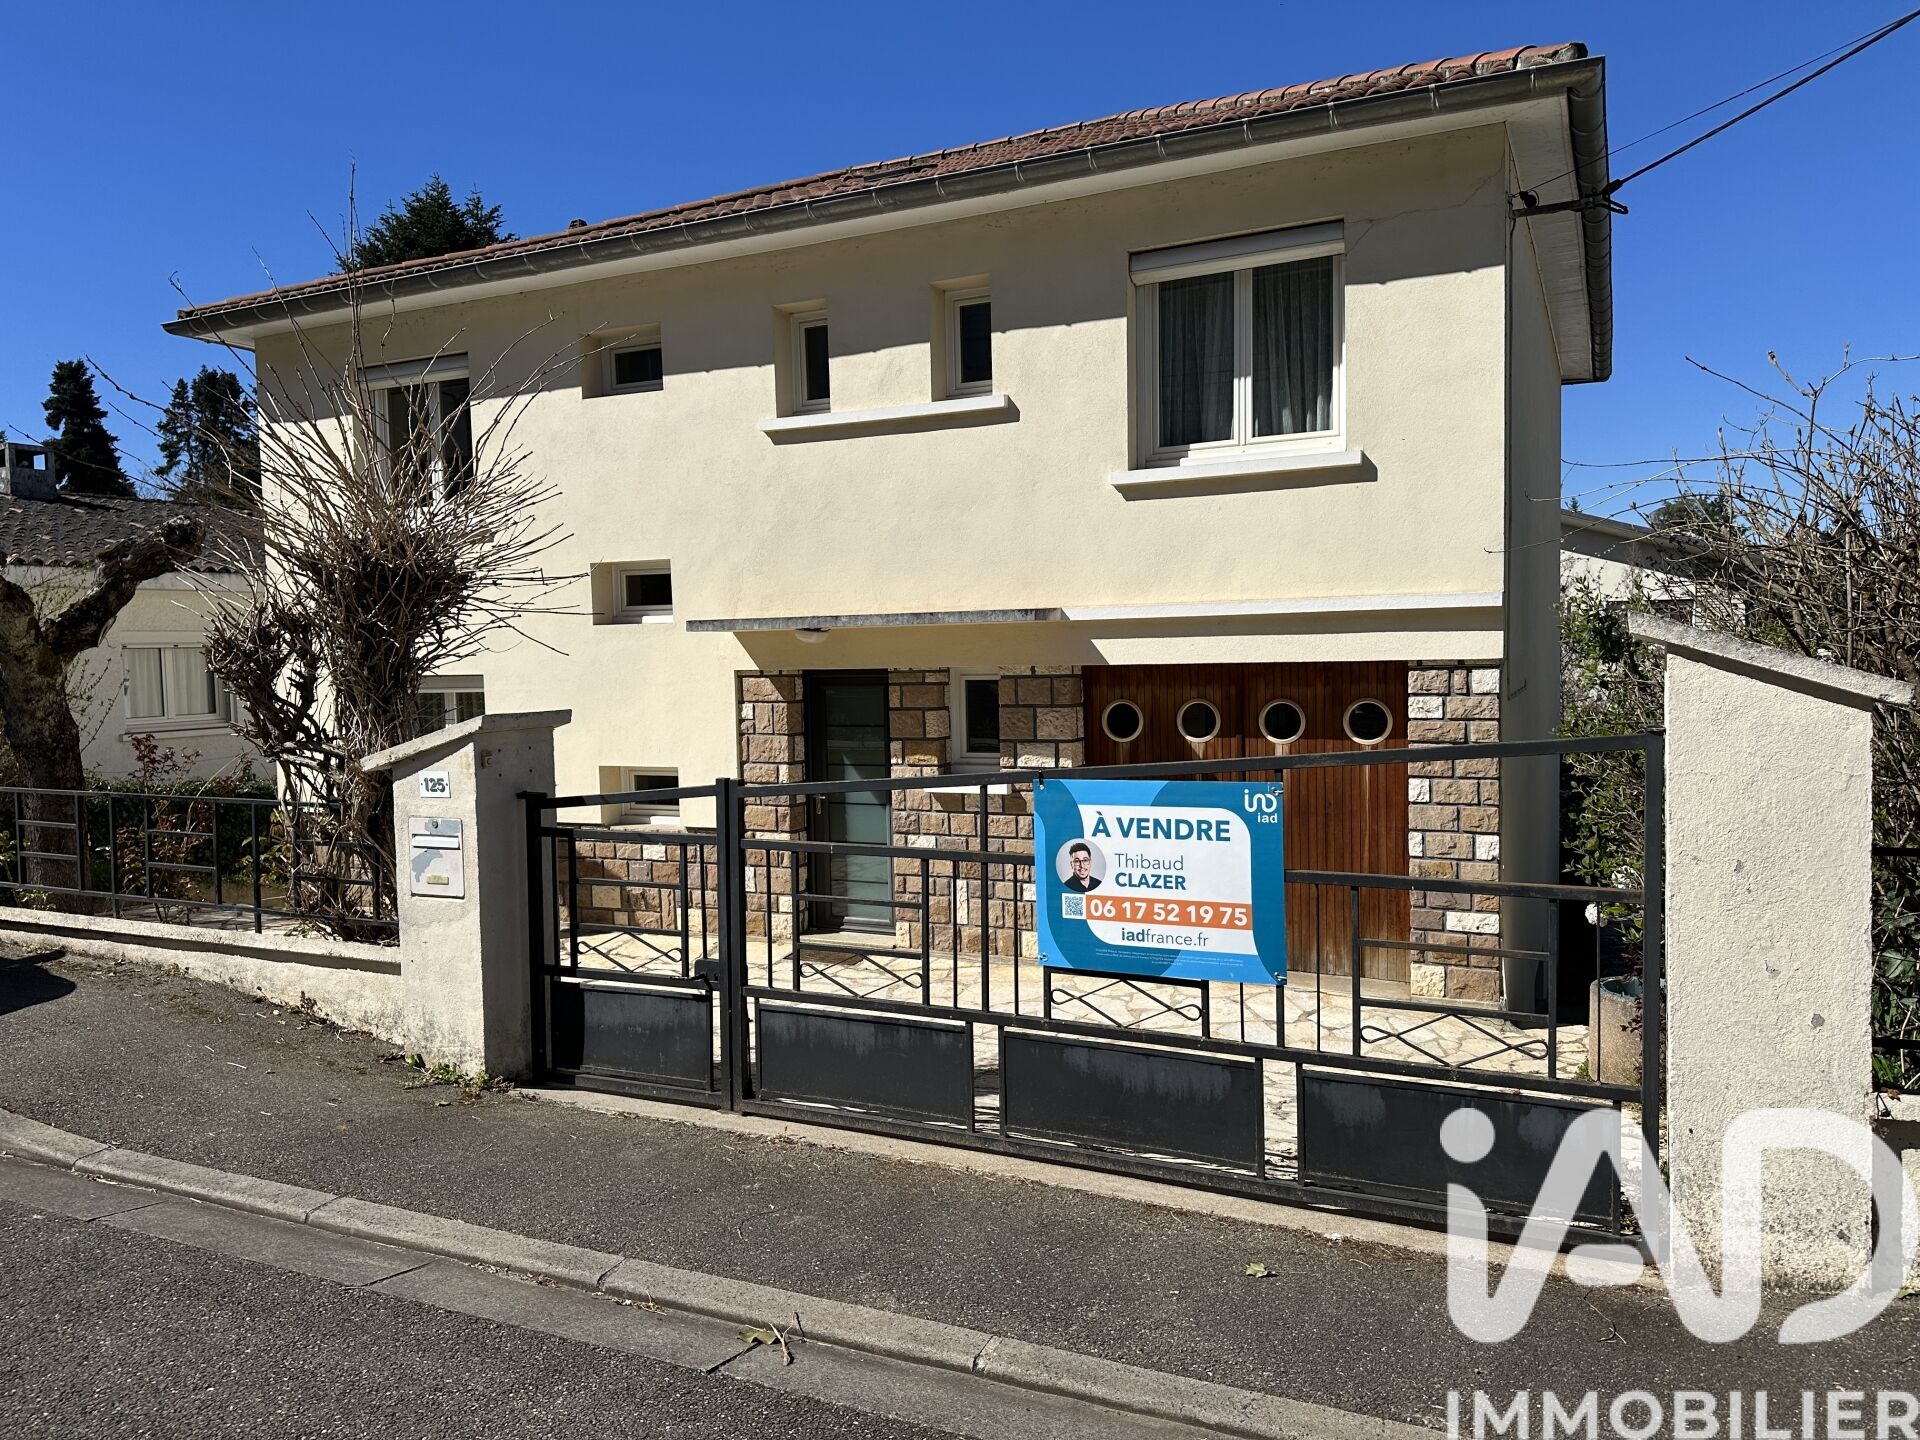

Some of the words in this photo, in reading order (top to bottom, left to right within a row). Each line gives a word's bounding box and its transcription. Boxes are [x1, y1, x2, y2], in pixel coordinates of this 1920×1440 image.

[424, 778, 446, 792] 125
[1091, 811, 1111, 838] À
[1116, 817, 1231, 842] VENDRE
[1257, 813, 1278, 824] iad
[1114, 853, 1184, 871] Thibaud
[1115, 872, 1187, 890] CLAZER
[1090, 900, 1116, 918] 06
[1122, 901, 1147, 919] 17
[1153, 904, 1180, 921] 52
[1186, 905, 1214, 924] 19
[1219, 907, 1247, 926] 75
[1121, 927, 1209, 947] iadfrance.fr
